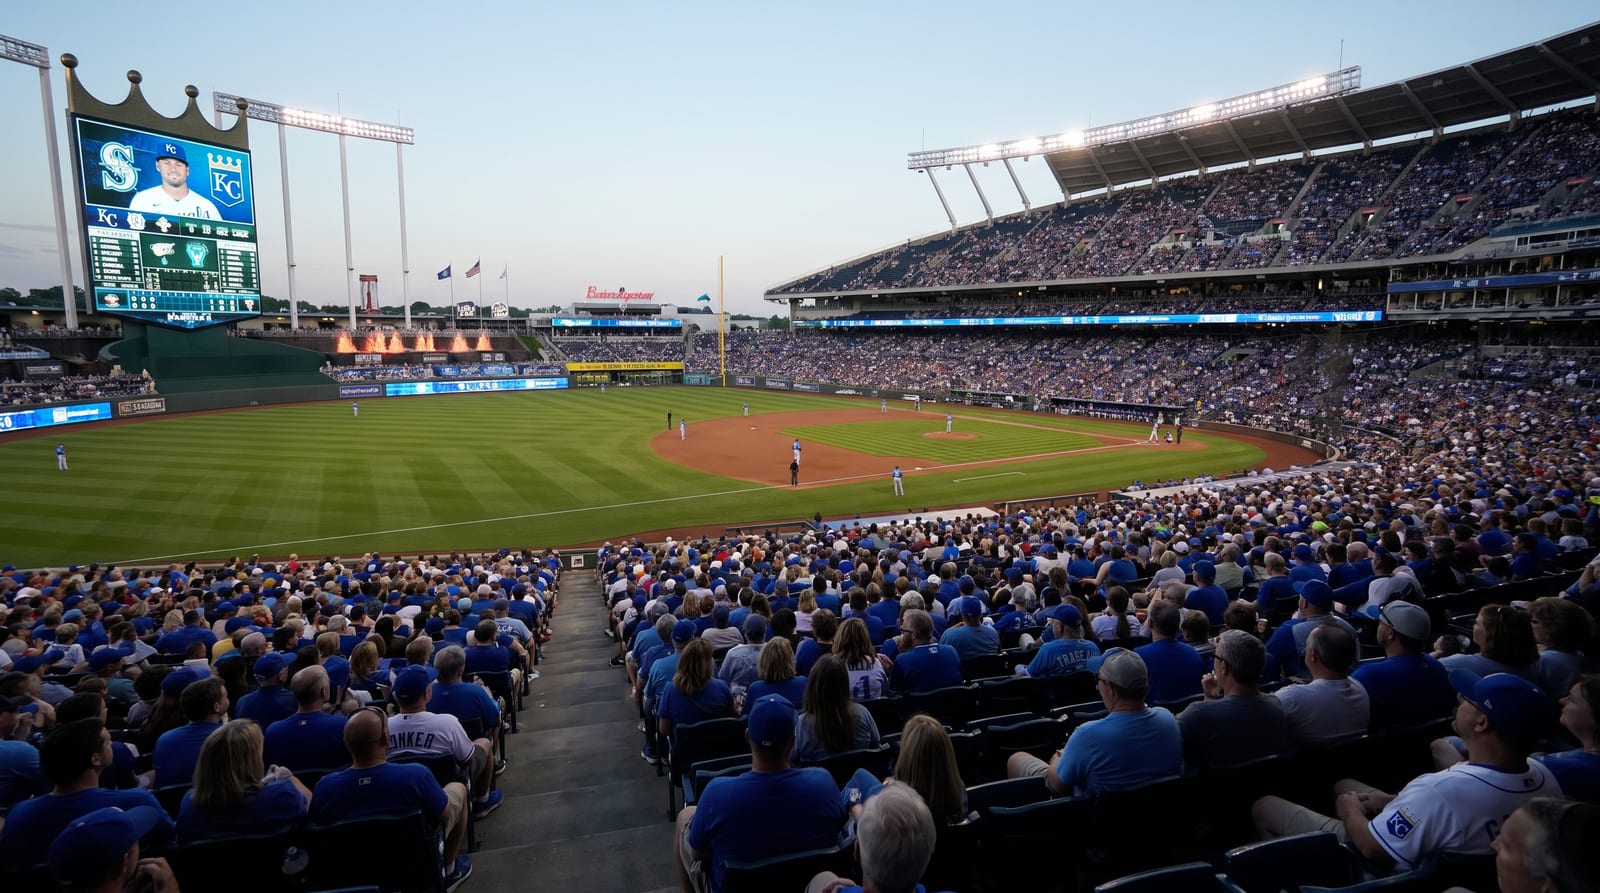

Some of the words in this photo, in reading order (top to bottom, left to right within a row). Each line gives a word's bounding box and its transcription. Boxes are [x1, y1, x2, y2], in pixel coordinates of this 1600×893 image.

[165, 143, 177, 155] KC
[99, 141, 138, 192] S
[212, 171, 241, 200] KC
[96, 208, 118, 228] KC
[1390, 813, 1409, 837] KC
